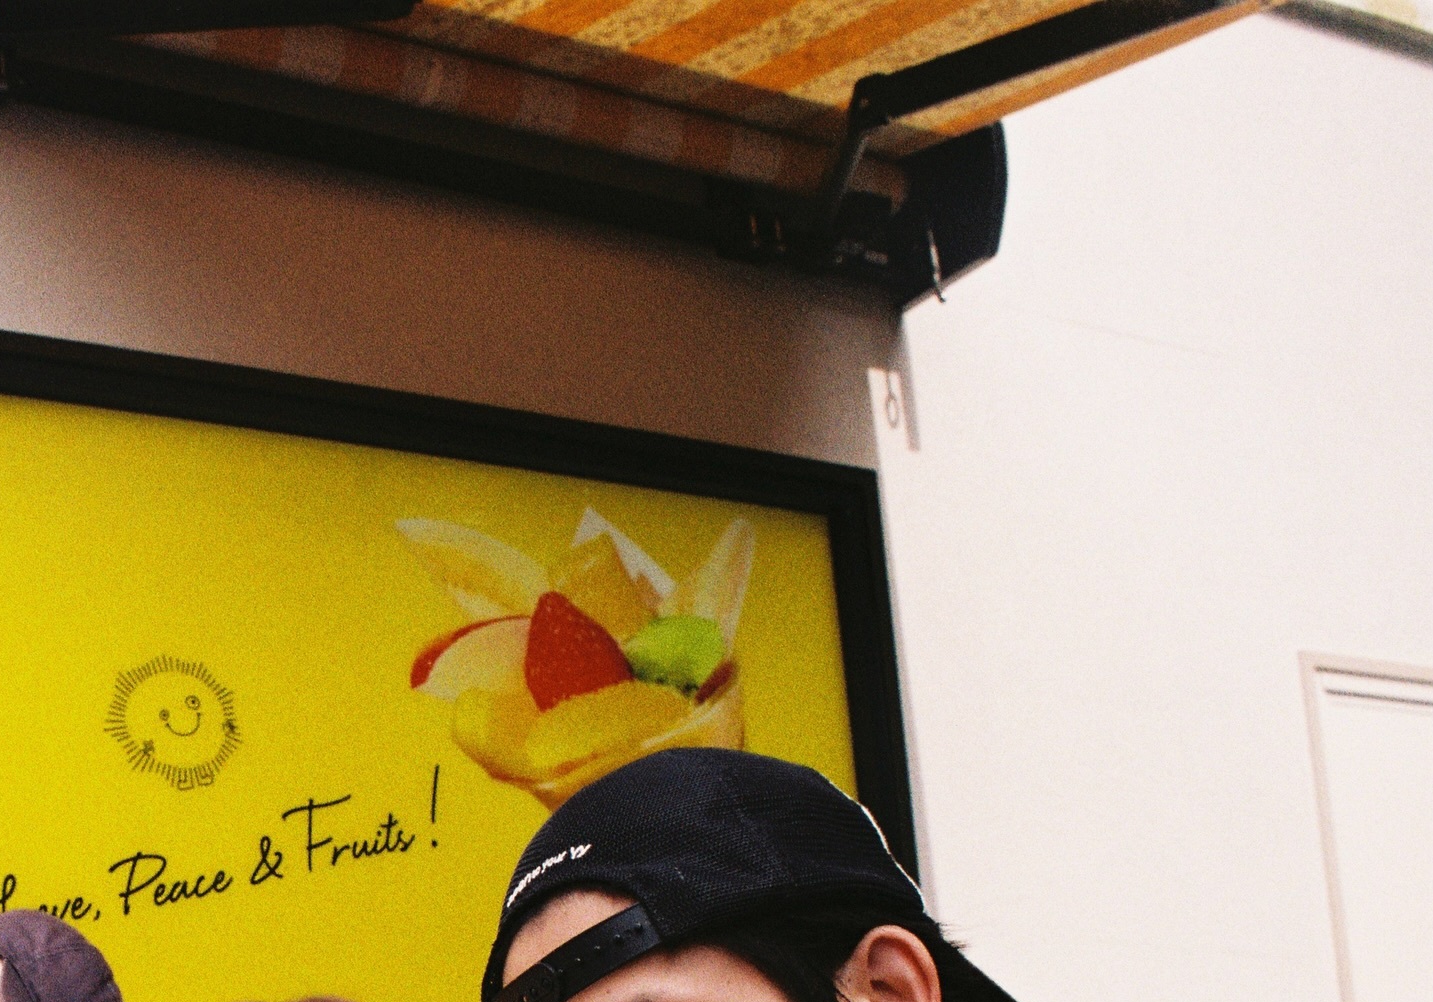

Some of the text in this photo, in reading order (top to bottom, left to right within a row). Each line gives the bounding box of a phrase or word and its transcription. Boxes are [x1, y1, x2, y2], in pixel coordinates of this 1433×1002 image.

[109, 851, 233, 915] Peace
[250, 836, 284, 884] &
[282, 765, 440, 873] Fruits!
